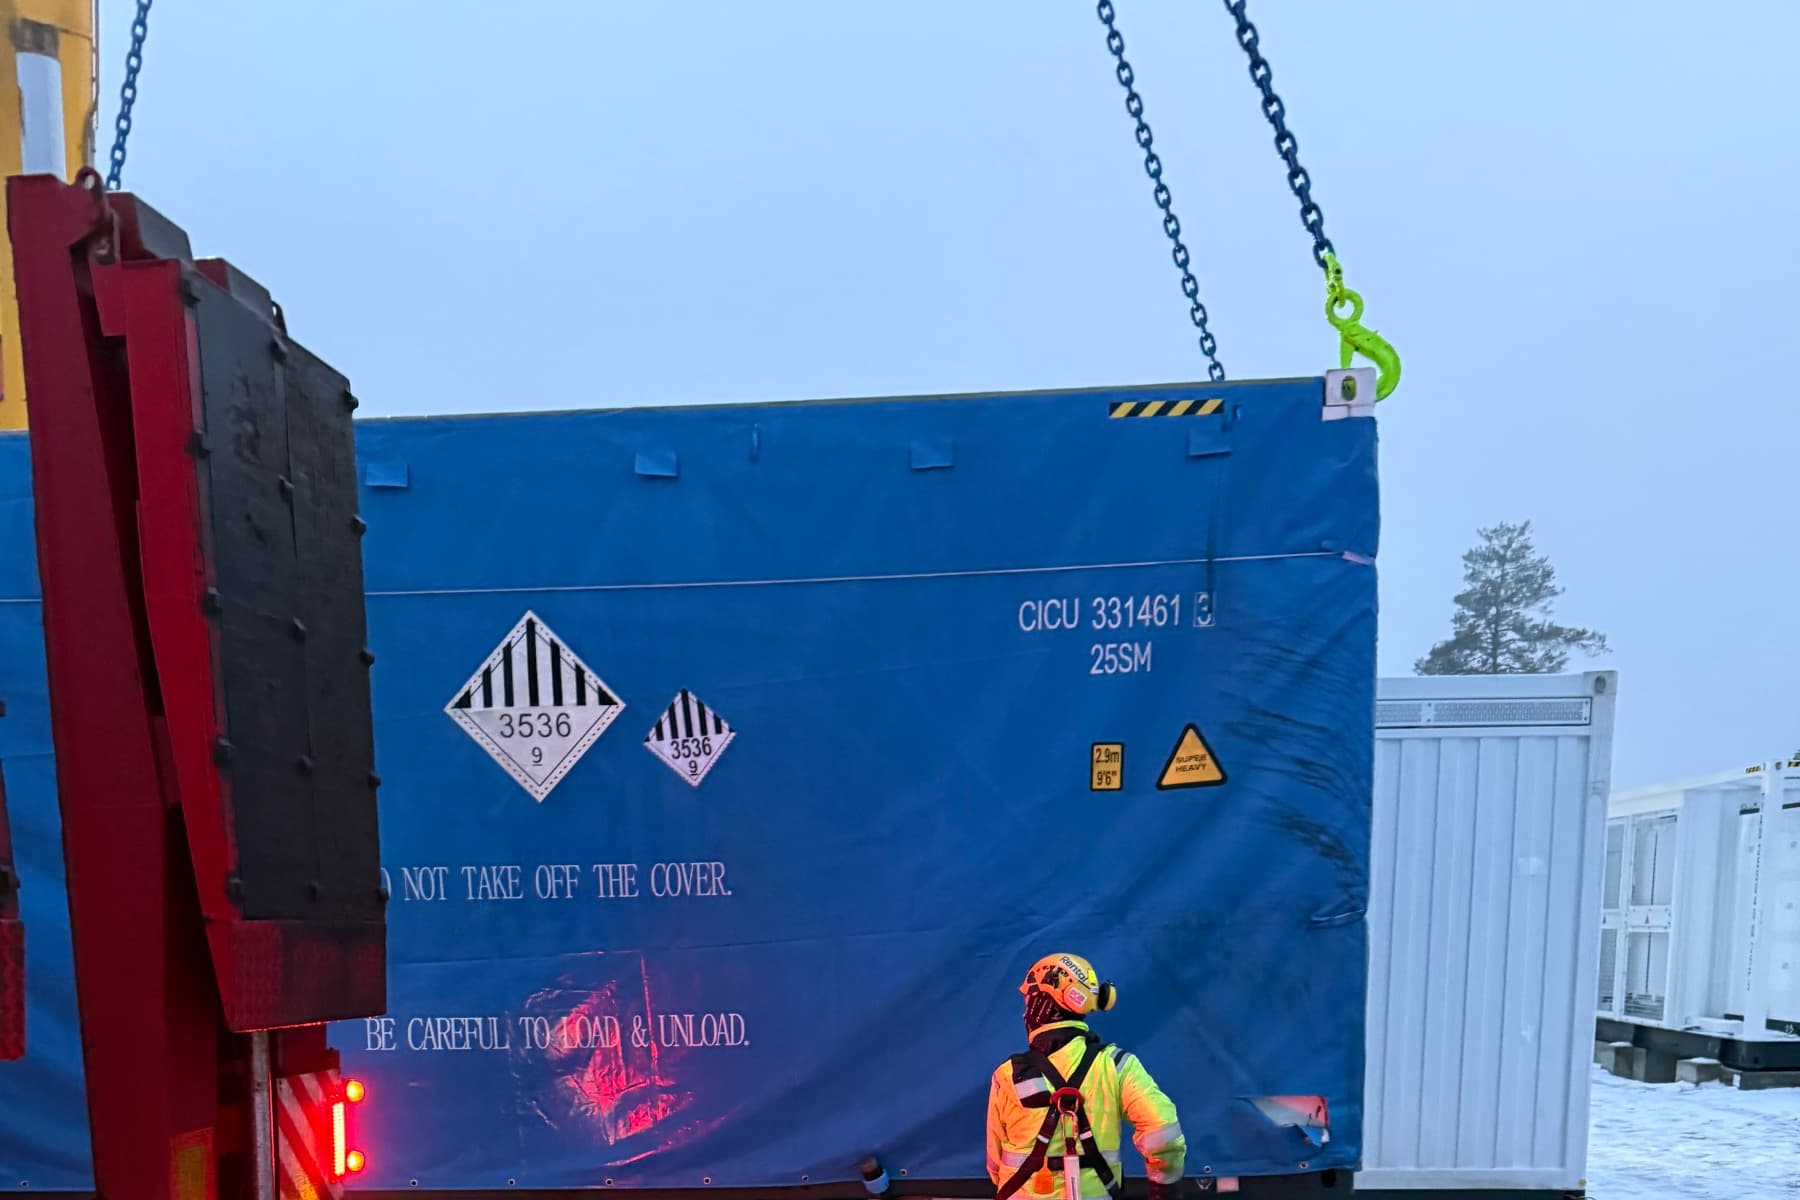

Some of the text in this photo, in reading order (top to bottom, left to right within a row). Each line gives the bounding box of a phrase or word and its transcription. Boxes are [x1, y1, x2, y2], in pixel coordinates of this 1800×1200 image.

[1018, 598, 1080, 632] CICU
[1091, 594, 1181, 629] 331461
[1089, 641, 1152, 675] 25SM
[499, 712, 572, 738] 3536
[532, 746, 543, 766] 9
[669, 736, 712, 760] 3536
[1095, 747, 1120, 764] 2.9m
[1175, 753, 1207, 764] SUPER
[688, 760, 699, 776] 9
[1175, 763, 1207, 773] HEAVY
[400, 866, 449, 901] NOT
[461, 865, 523, 900] TAKE
[535, 864, 580, 899] OFF
[592, 863, 640, 899] THE
[650, 861, 733, 897] COVER.
[365, 1012, 750, 1051] BE CAREFUL TO LOAD & UNLOAD.
